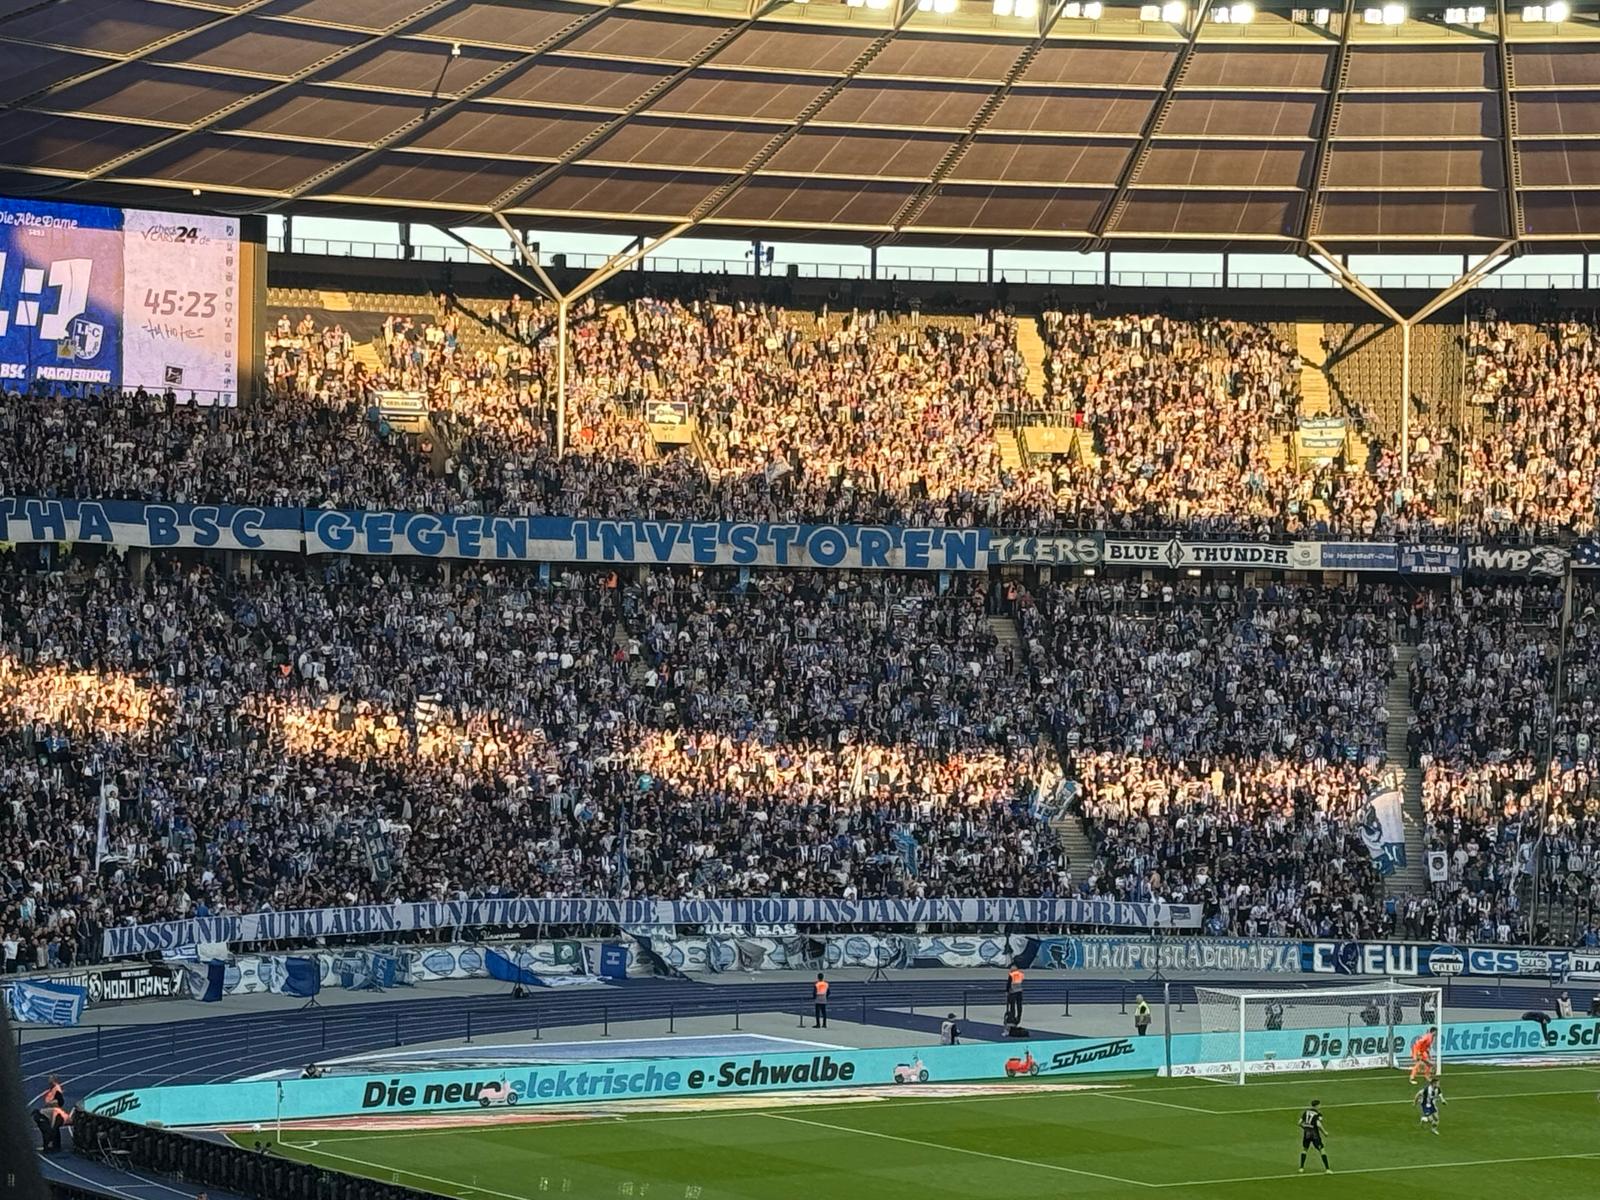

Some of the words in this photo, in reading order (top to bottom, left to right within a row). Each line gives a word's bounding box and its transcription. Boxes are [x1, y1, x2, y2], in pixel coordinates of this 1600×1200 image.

[42, 215, 78, 229] Dame
[144, 288, 217, 318] 45:23
[0, 363, 26, 379] BSC
[144, 504, 266, 549] BSC
[315, 511, 528, 560] GEGEN
[570, 519, 980, 569] INVESTOREN
[1110, 544, 1159, 561] BLUE
[1192, 546, 1288, 564] THUNDER
[254, 904, 402, 940] AUFKLÄREN,
[413, 899, 660, 929] FUNKTIONIERENDE
[672, 899, 963, 923] KONTROLLINSTANZEN
[977, 899, 1162, 927] ETABLIEREN!
[1471, 951, 1519, 972] GS
[103, 976, 170, 999] HOOLIGANS
[1302, 1033, 1342, 1058] Die
[1350, 1034, 1405, 1056] neue
[1411, 1024, 1541, 1051] ektrische
[362, 1078, 417, 1109] Die
[509, 1067, 682, 1099] elektrische
